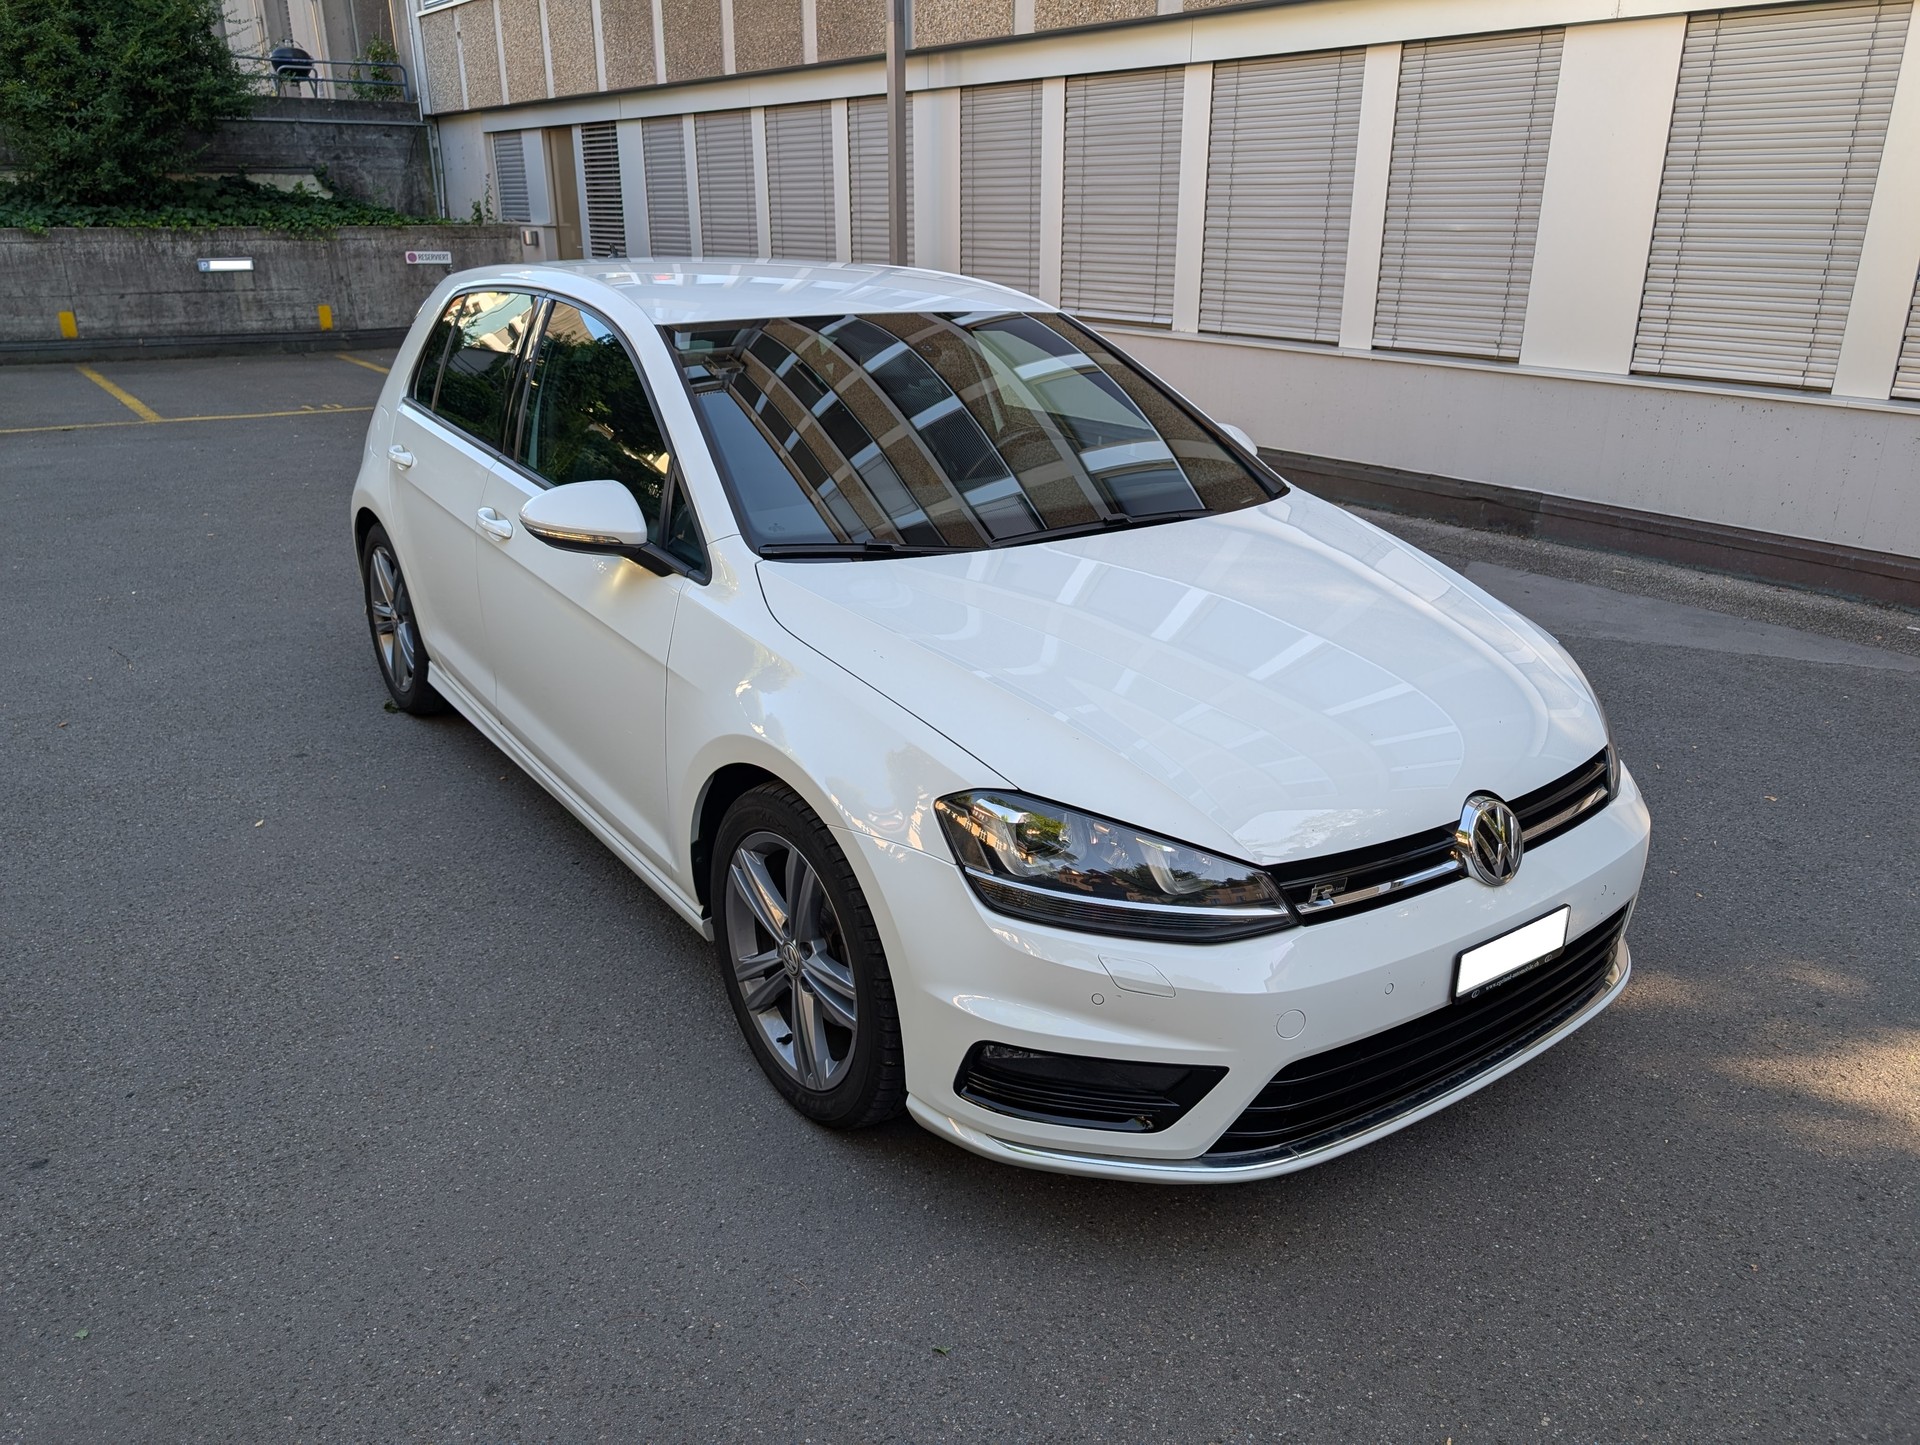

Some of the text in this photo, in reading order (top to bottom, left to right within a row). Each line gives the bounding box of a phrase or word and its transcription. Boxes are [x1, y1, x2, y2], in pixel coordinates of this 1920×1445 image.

[417, 253, 449, 261] RESERVIERT
[201, 261, 208, 271] P
[1470, 801, 1521, 884] VW
